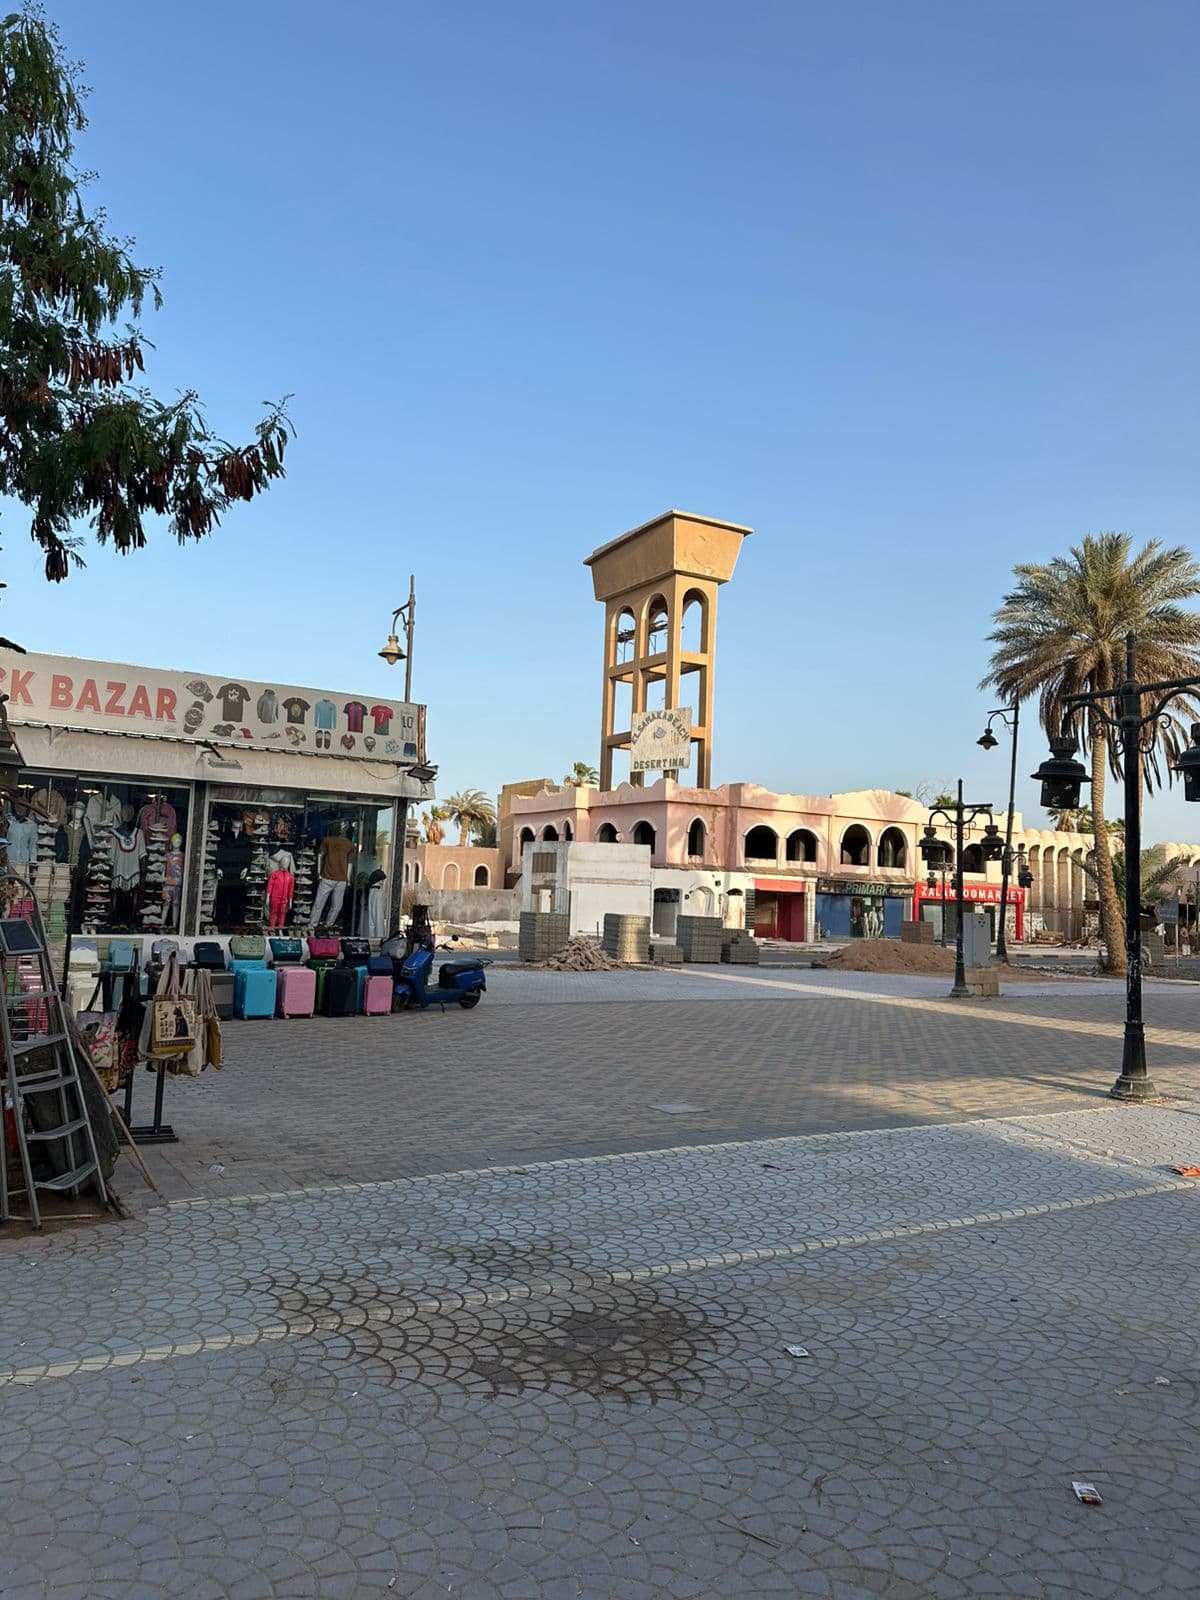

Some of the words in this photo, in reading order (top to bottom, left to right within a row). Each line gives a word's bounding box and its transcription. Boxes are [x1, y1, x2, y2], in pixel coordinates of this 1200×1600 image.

[0, 667, 36, 704] K
[50, 674, 177, 721] BAZAR
[402, 716, 413, 728] 10
[633, 759, 667, 769] DESERT
[669, 758, 685, 768] INN
[846, 883, 888, 896] PRIMARK
